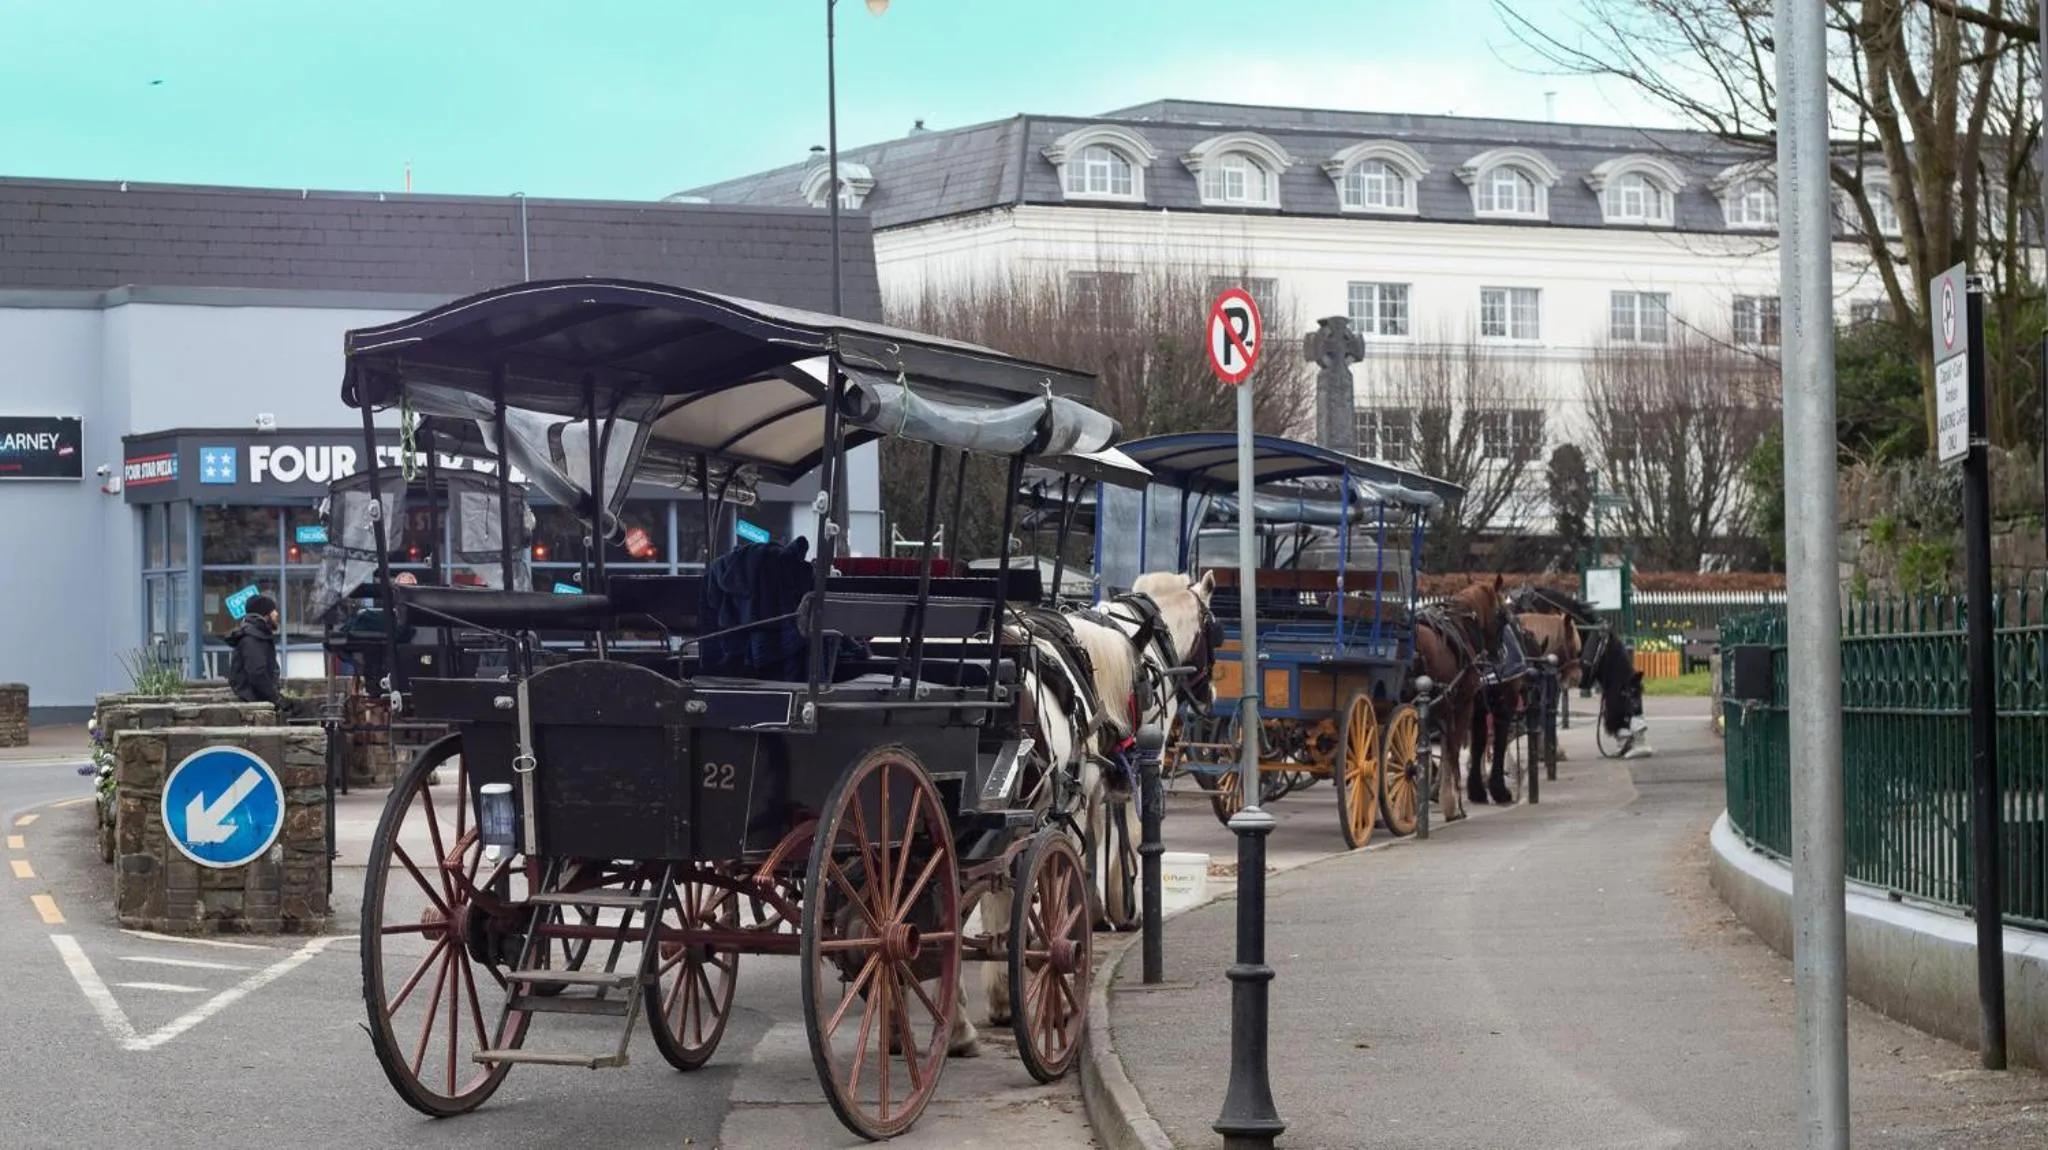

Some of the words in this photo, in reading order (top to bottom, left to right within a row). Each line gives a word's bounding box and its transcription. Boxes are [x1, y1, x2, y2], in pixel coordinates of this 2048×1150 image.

[0, 432, 59, 450] ARNEY
[250, 446, 356, 483] FOUR
[703, 762, 735, 789] 22
